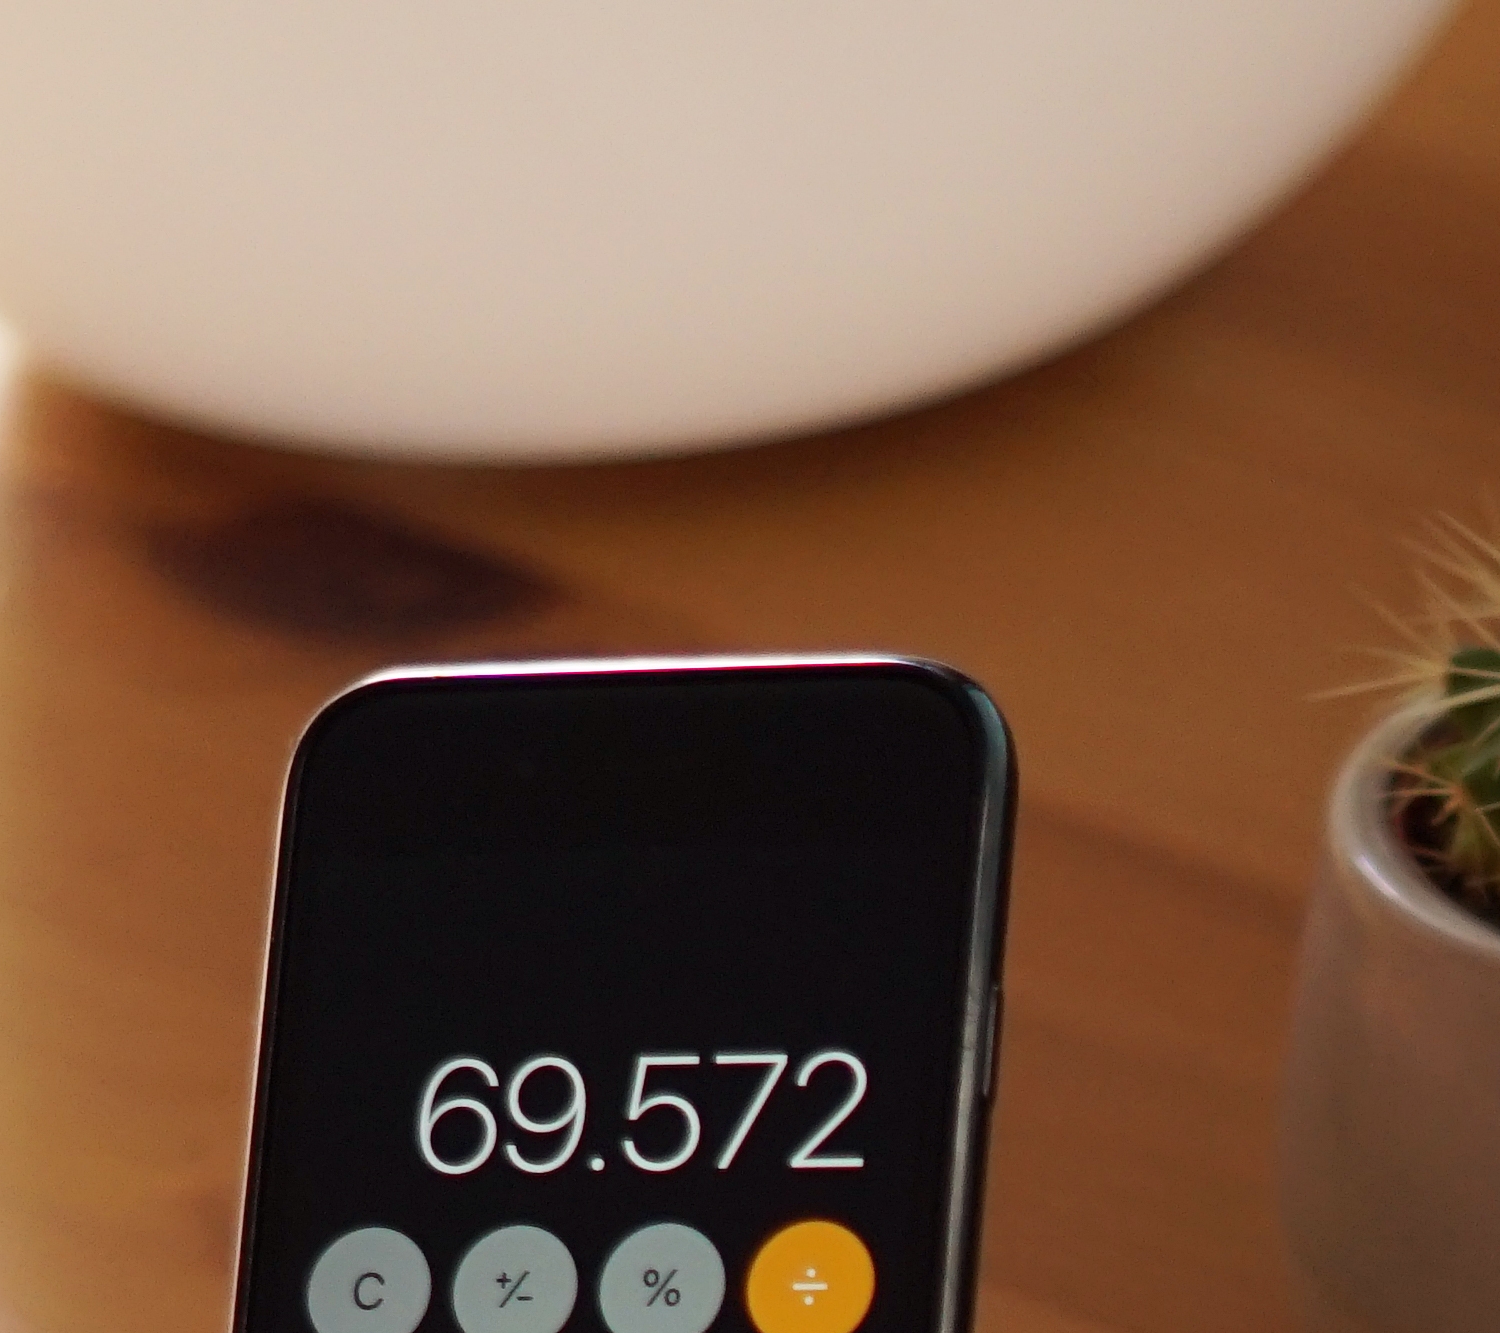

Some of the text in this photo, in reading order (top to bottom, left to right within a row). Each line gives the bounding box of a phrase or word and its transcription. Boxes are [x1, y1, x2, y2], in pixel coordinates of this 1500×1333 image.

[418, 1051, 867, 1174] 69.572
[352, 1271, 385, 1311] C
[642, 1267, 682, 1308] %
